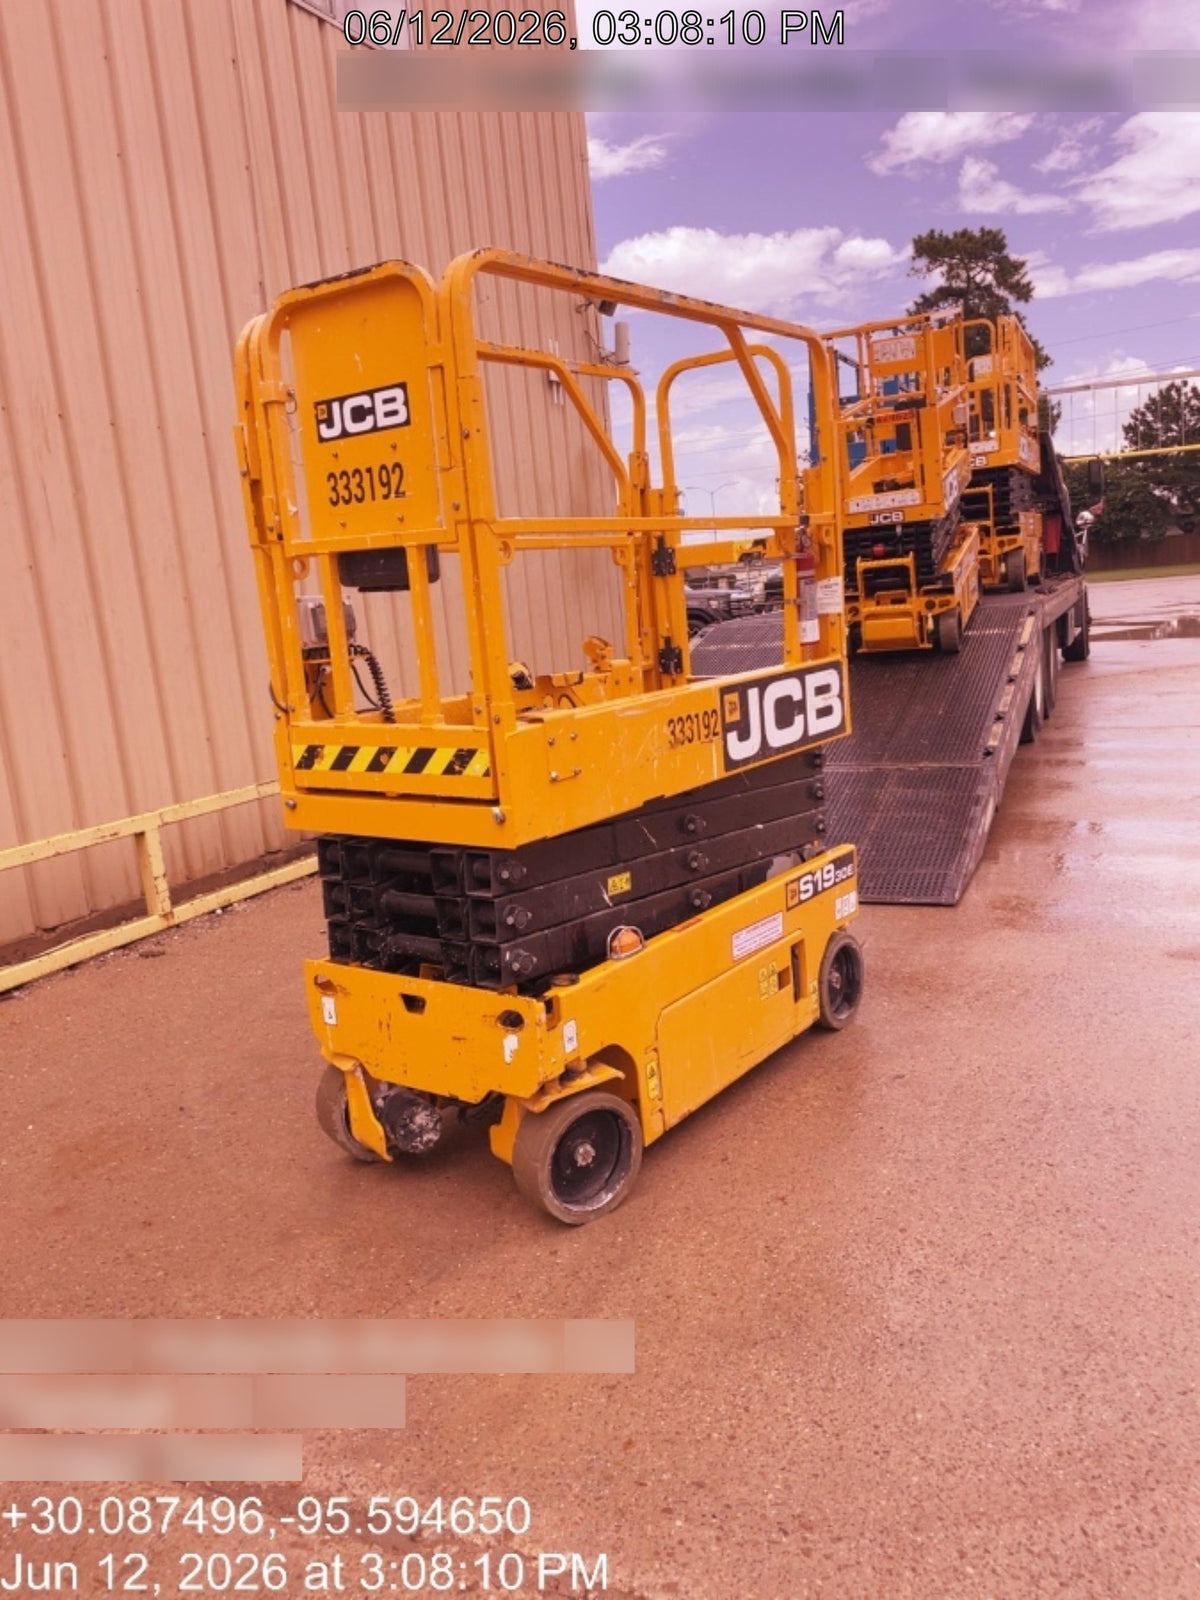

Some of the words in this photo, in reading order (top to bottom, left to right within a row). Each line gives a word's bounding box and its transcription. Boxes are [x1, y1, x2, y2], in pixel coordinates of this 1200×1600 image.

[319, 387, 407, 439] JCB
[327, 462, 406, 507] 333192
[870, 511, 904, 525] JCB
[667, 709, 719, 749] 333192
[726, 668, 843, 761] JCB
